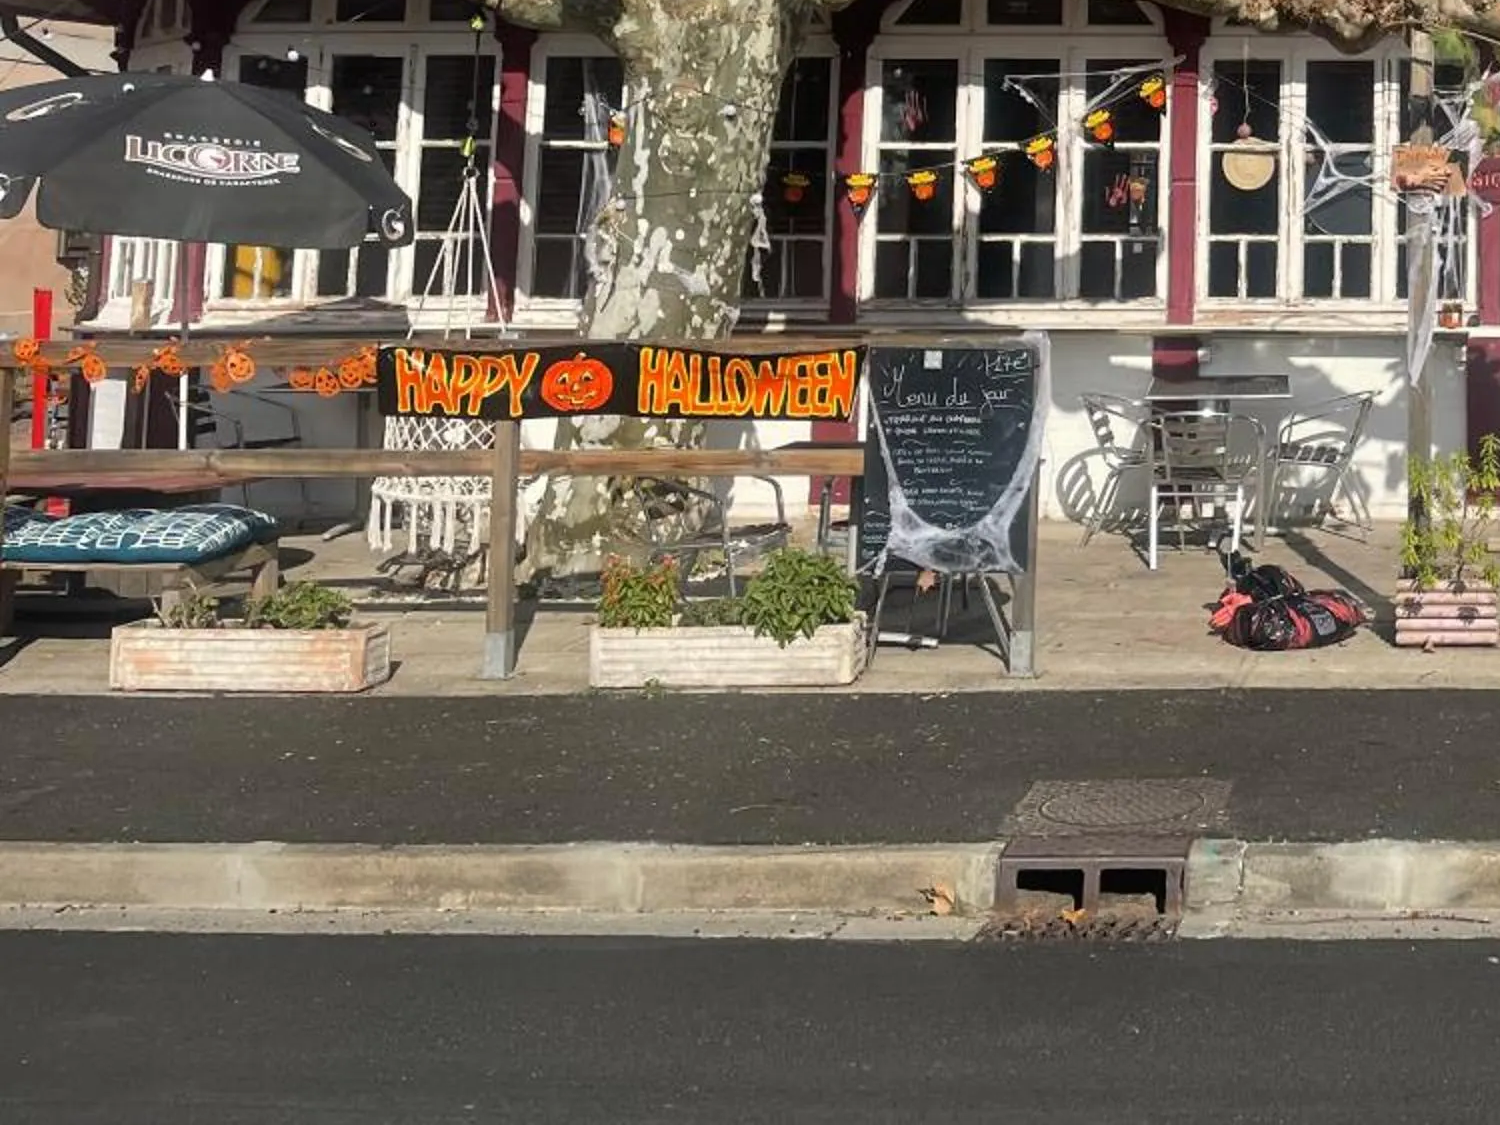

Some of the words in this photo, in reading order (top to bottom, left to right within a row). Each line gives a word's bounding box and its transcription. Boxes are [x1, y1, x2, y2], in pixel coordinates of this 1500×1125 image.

[125, 134, 301, 175] LICORNE
[395, 348, 541, 416] HAPPY
[638, 346, 857, 417] HALLOWEEN
[883, 364, 937, 408] Menu
[945, 377, 971, 406] du
[980, 384, 1014, 415] jour
